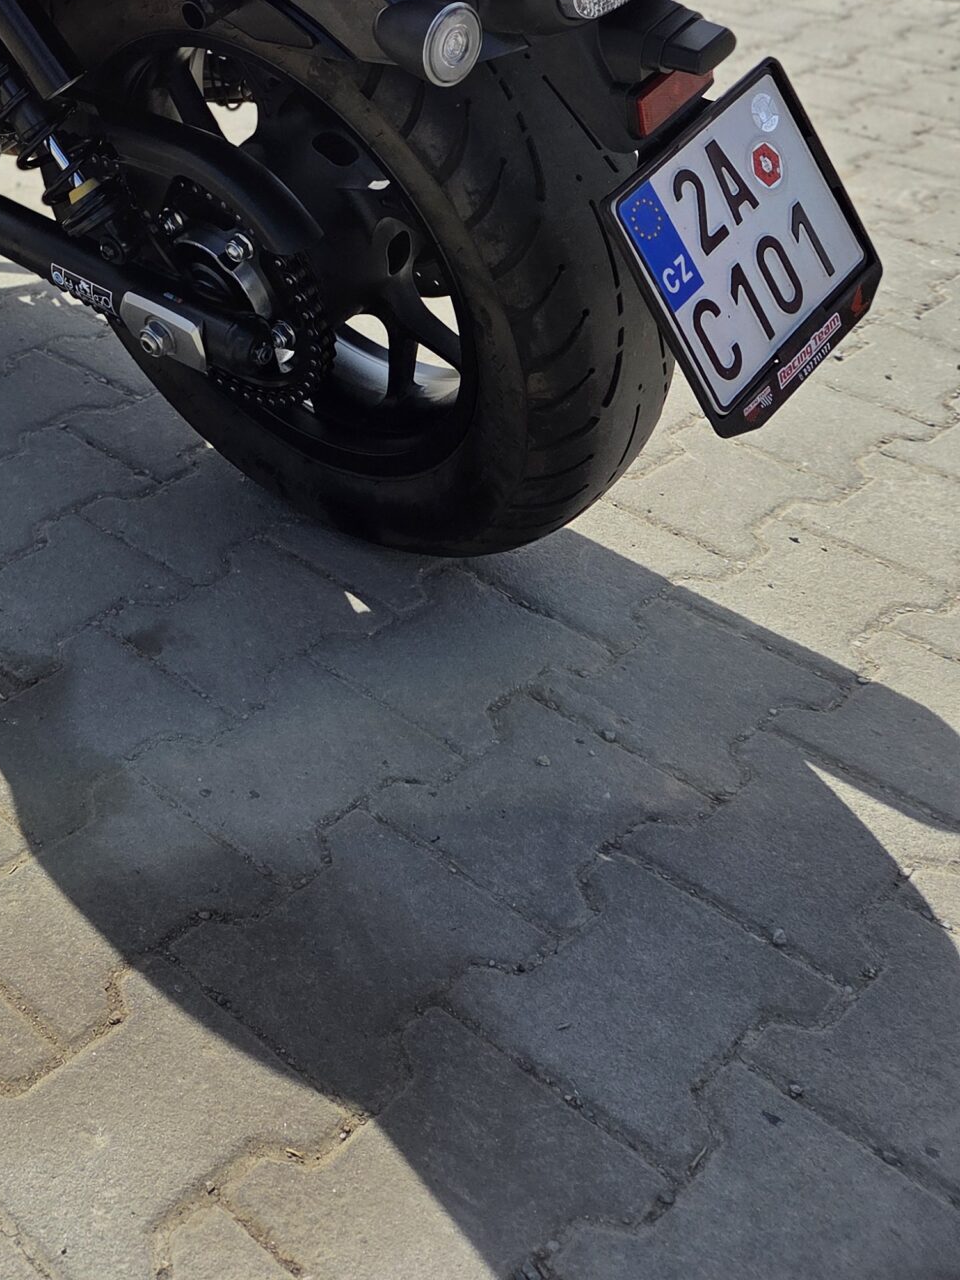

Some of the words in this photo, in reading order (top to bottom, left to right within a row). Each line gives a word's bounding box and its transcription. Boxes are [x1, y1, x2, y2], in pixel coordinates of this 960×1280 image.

[673, 139, 760, 256] 2A
[662, 255, 694, 294] CZ
[693, 201, 835, 381] C101
[779, 344, 813, 384] Racing
[810, 314, 840, 347] Team
